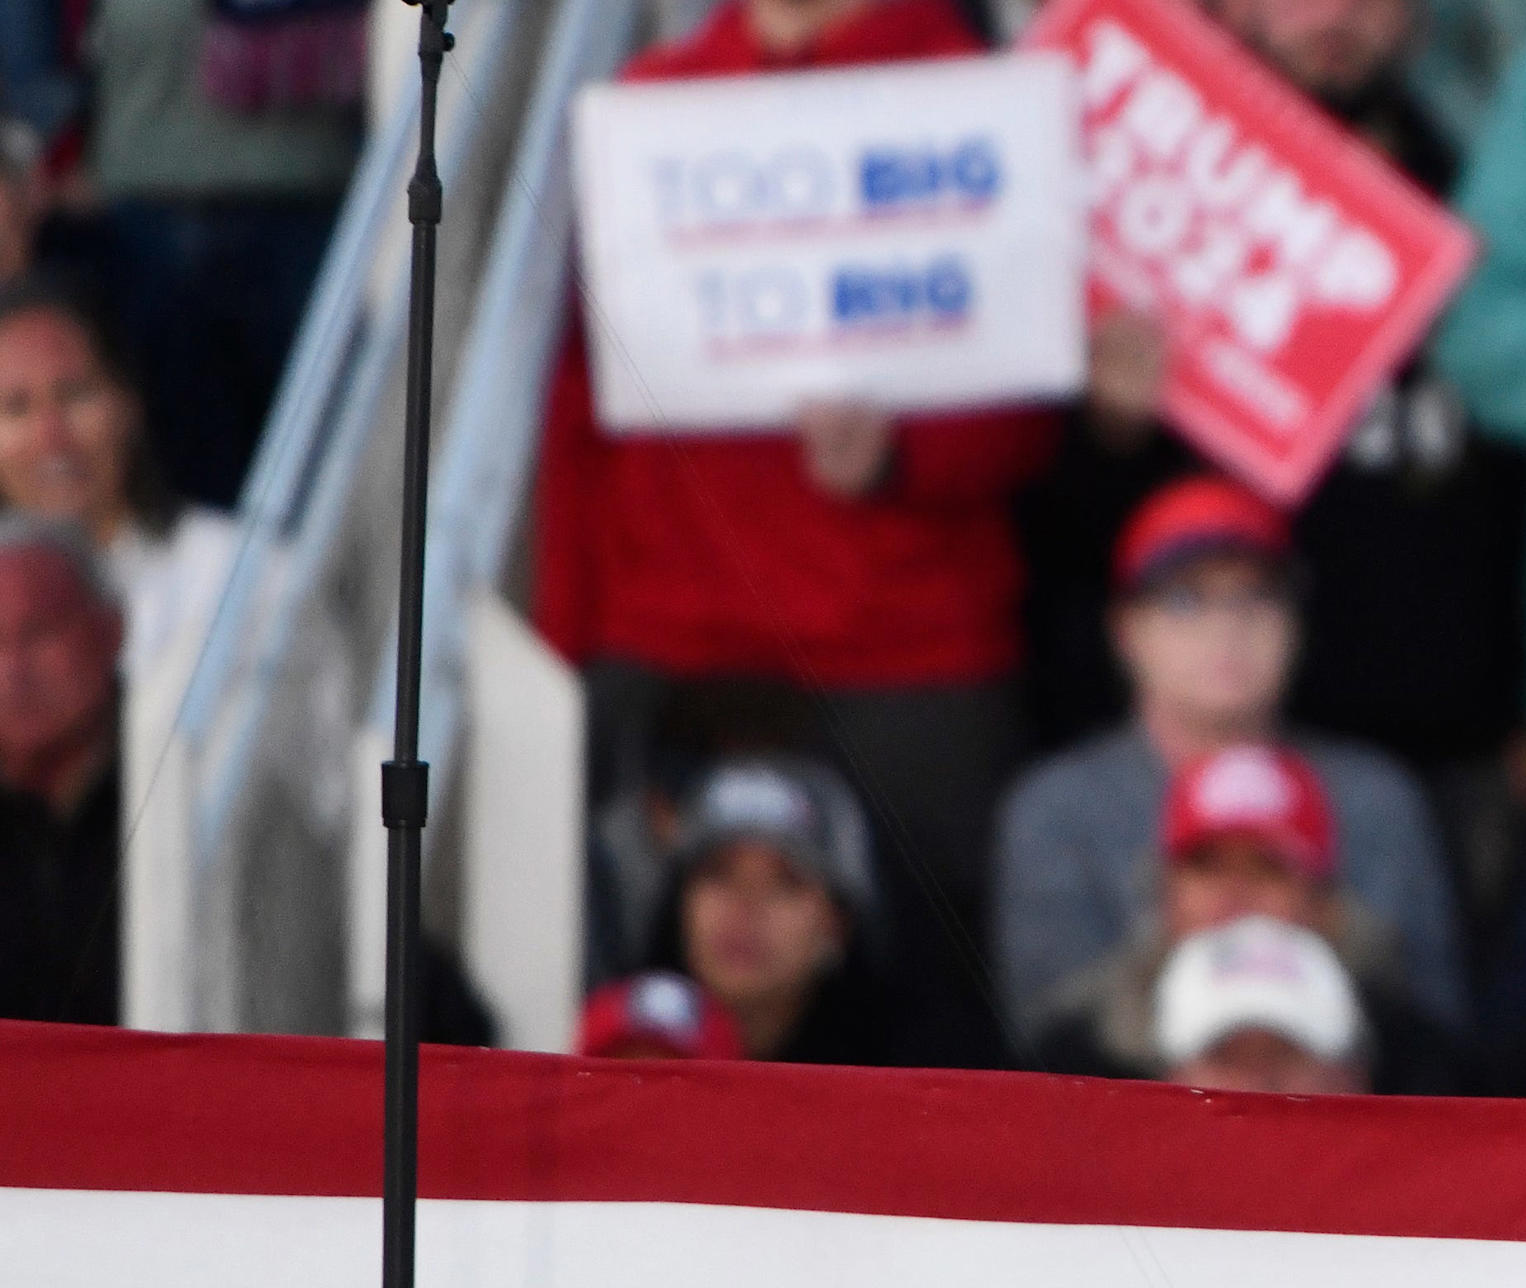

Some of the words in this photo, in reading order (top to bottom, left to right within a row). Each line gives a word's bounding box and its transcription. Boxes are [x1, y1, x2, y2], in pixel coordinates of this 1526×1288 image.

[652, 146, 839, 222] TOO
[858, 132, 1003, 209] BIG
[697, 262, 806, 334] TO
